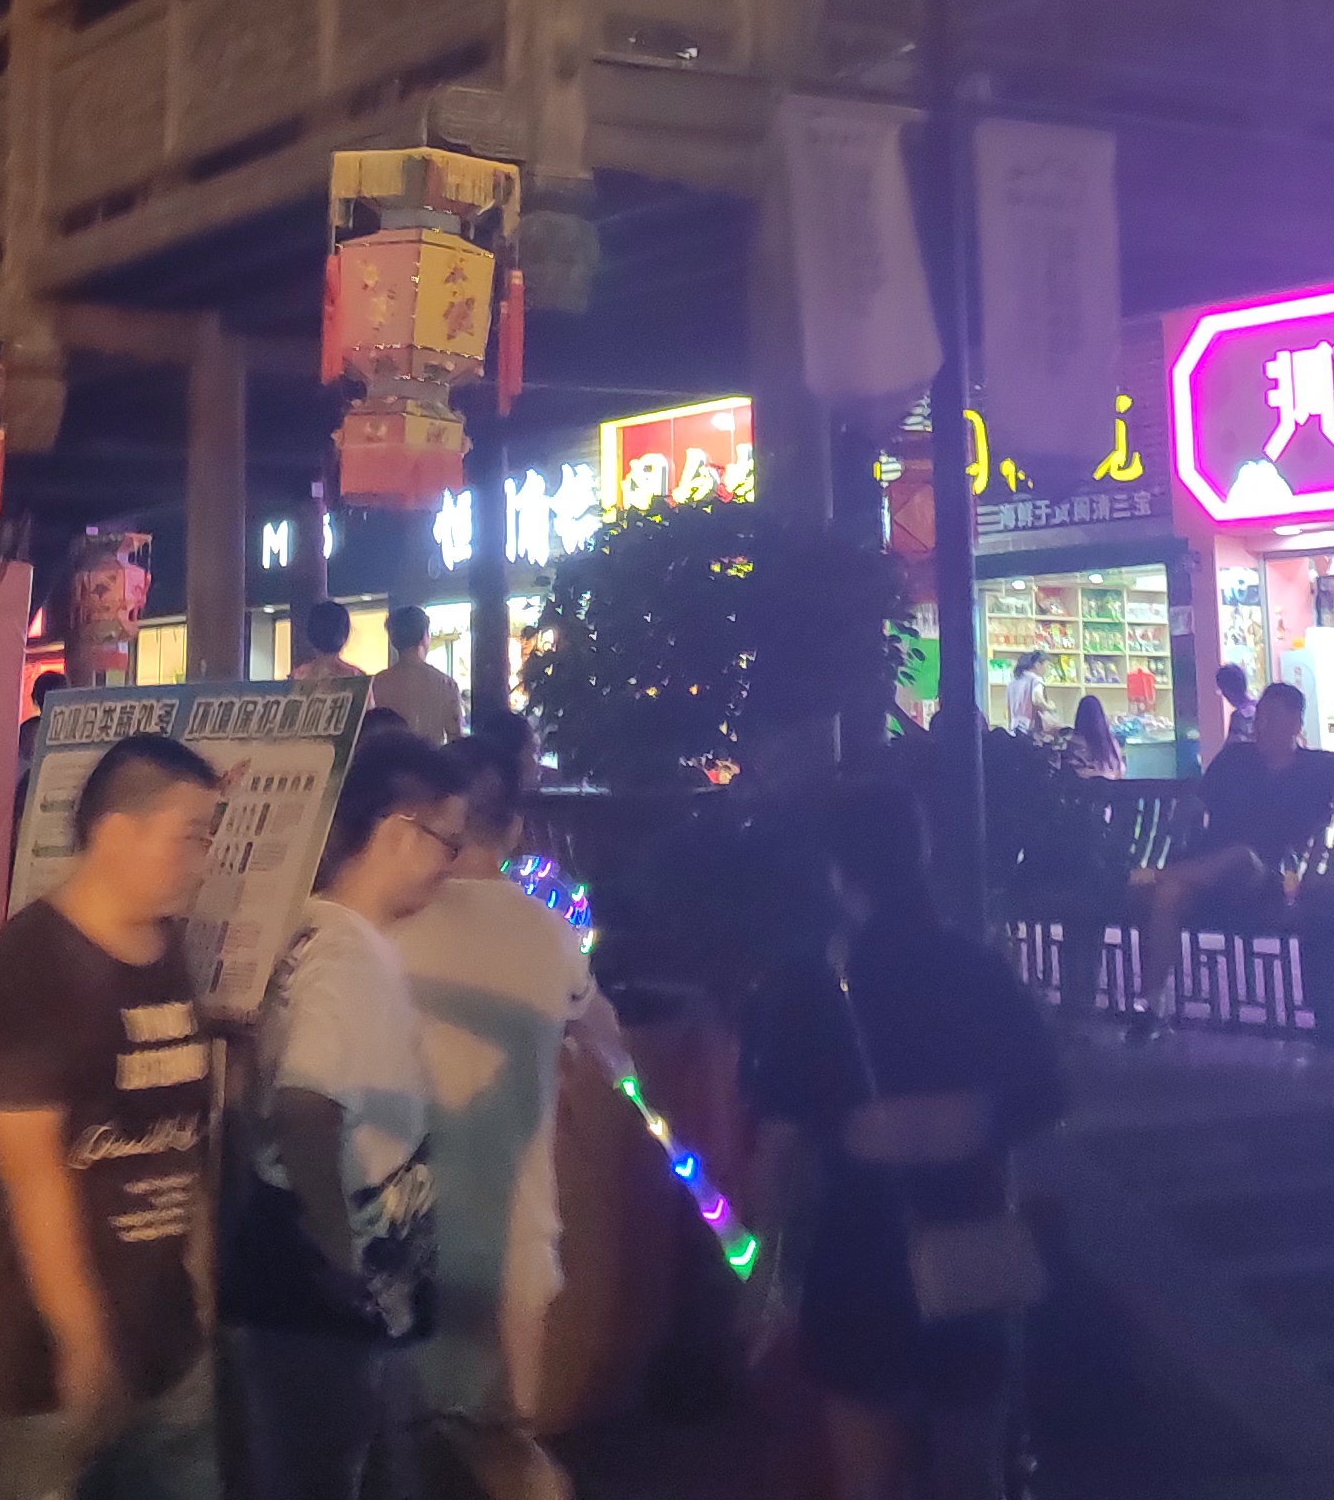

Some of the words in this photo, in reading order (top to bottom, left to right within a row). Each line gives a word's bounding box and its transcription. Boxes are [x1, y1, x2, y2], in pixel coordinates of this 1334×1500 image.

[184, 691, 353, 741] 环境保护靠你我
